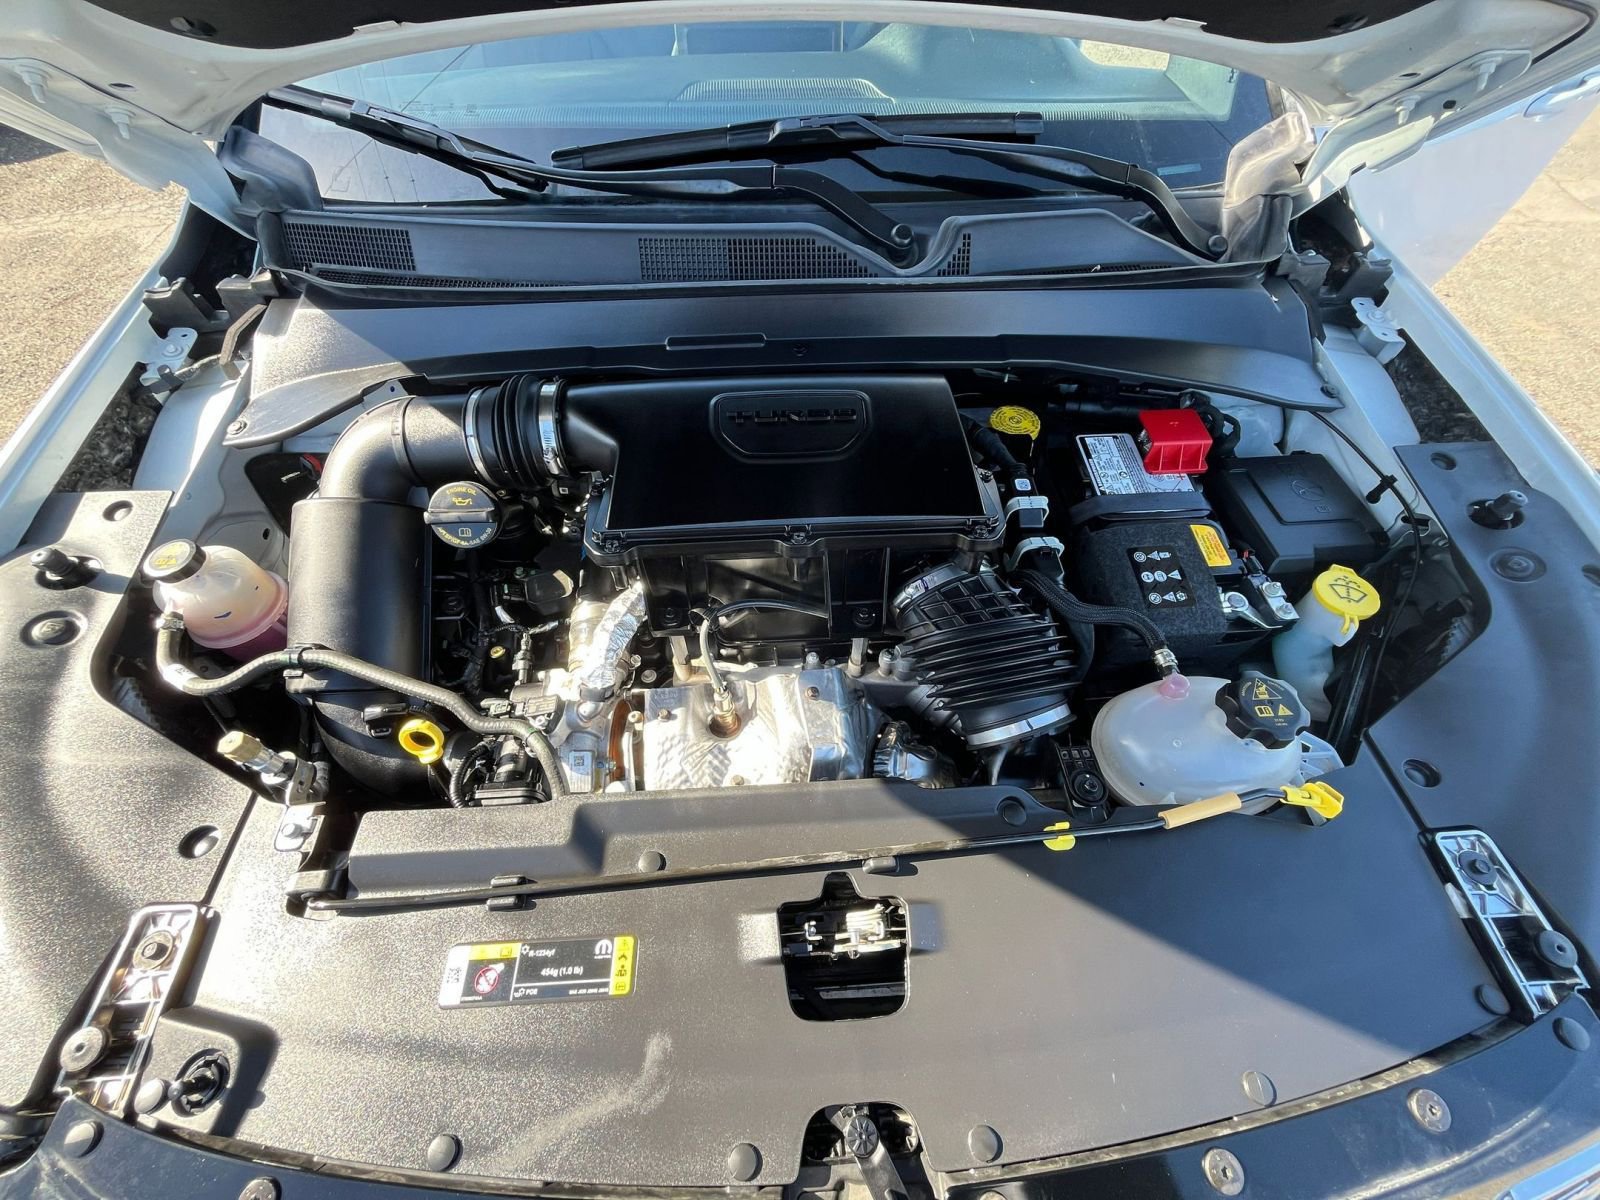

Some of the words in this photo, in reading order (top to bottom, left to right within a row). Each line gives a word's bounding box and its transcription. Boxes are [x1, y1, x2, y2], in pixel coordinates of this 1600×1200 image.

[447, 486, 466, 494] ENGINE
[529, 948, 556, 957] R-1234yf
[541, 967, 559, 977] 454g
[560, 966, 572, 977] (1.0
